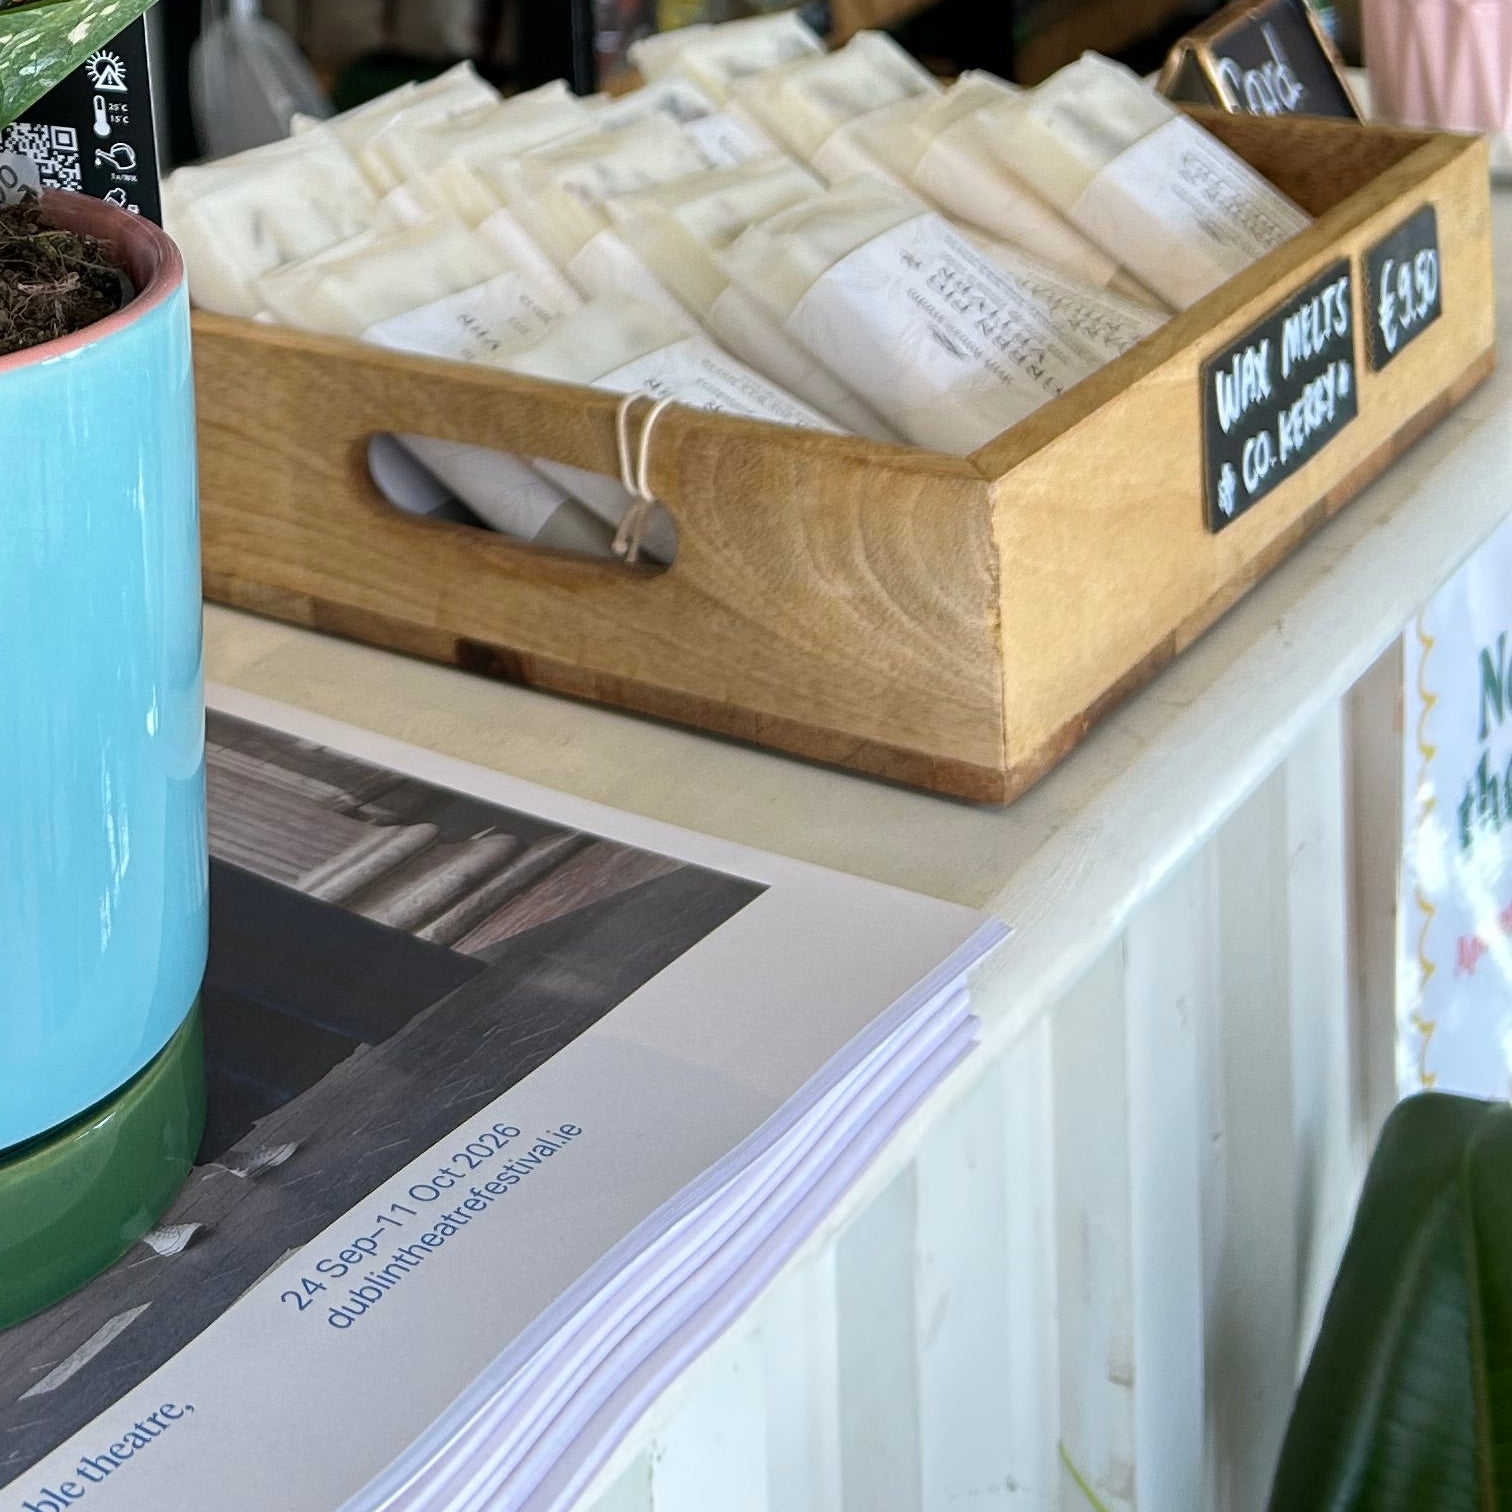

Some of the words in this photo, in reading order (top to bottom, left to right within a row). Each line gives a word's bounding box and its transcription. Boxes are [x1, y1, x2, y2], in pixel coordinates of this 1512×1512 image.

[1215, 338, 1272, 434] WAX
[1281, 276, 1348, 380] MELTS
[280, 1276, 327, 1312] 24
[408, 1166, 467, 1202] Oct
[452, 1122, 522, 1170] 2026
[327, 1121, 583, 1329] dublintheatrefestival.ie
[76, 1402, 195, 1483] theatre,
